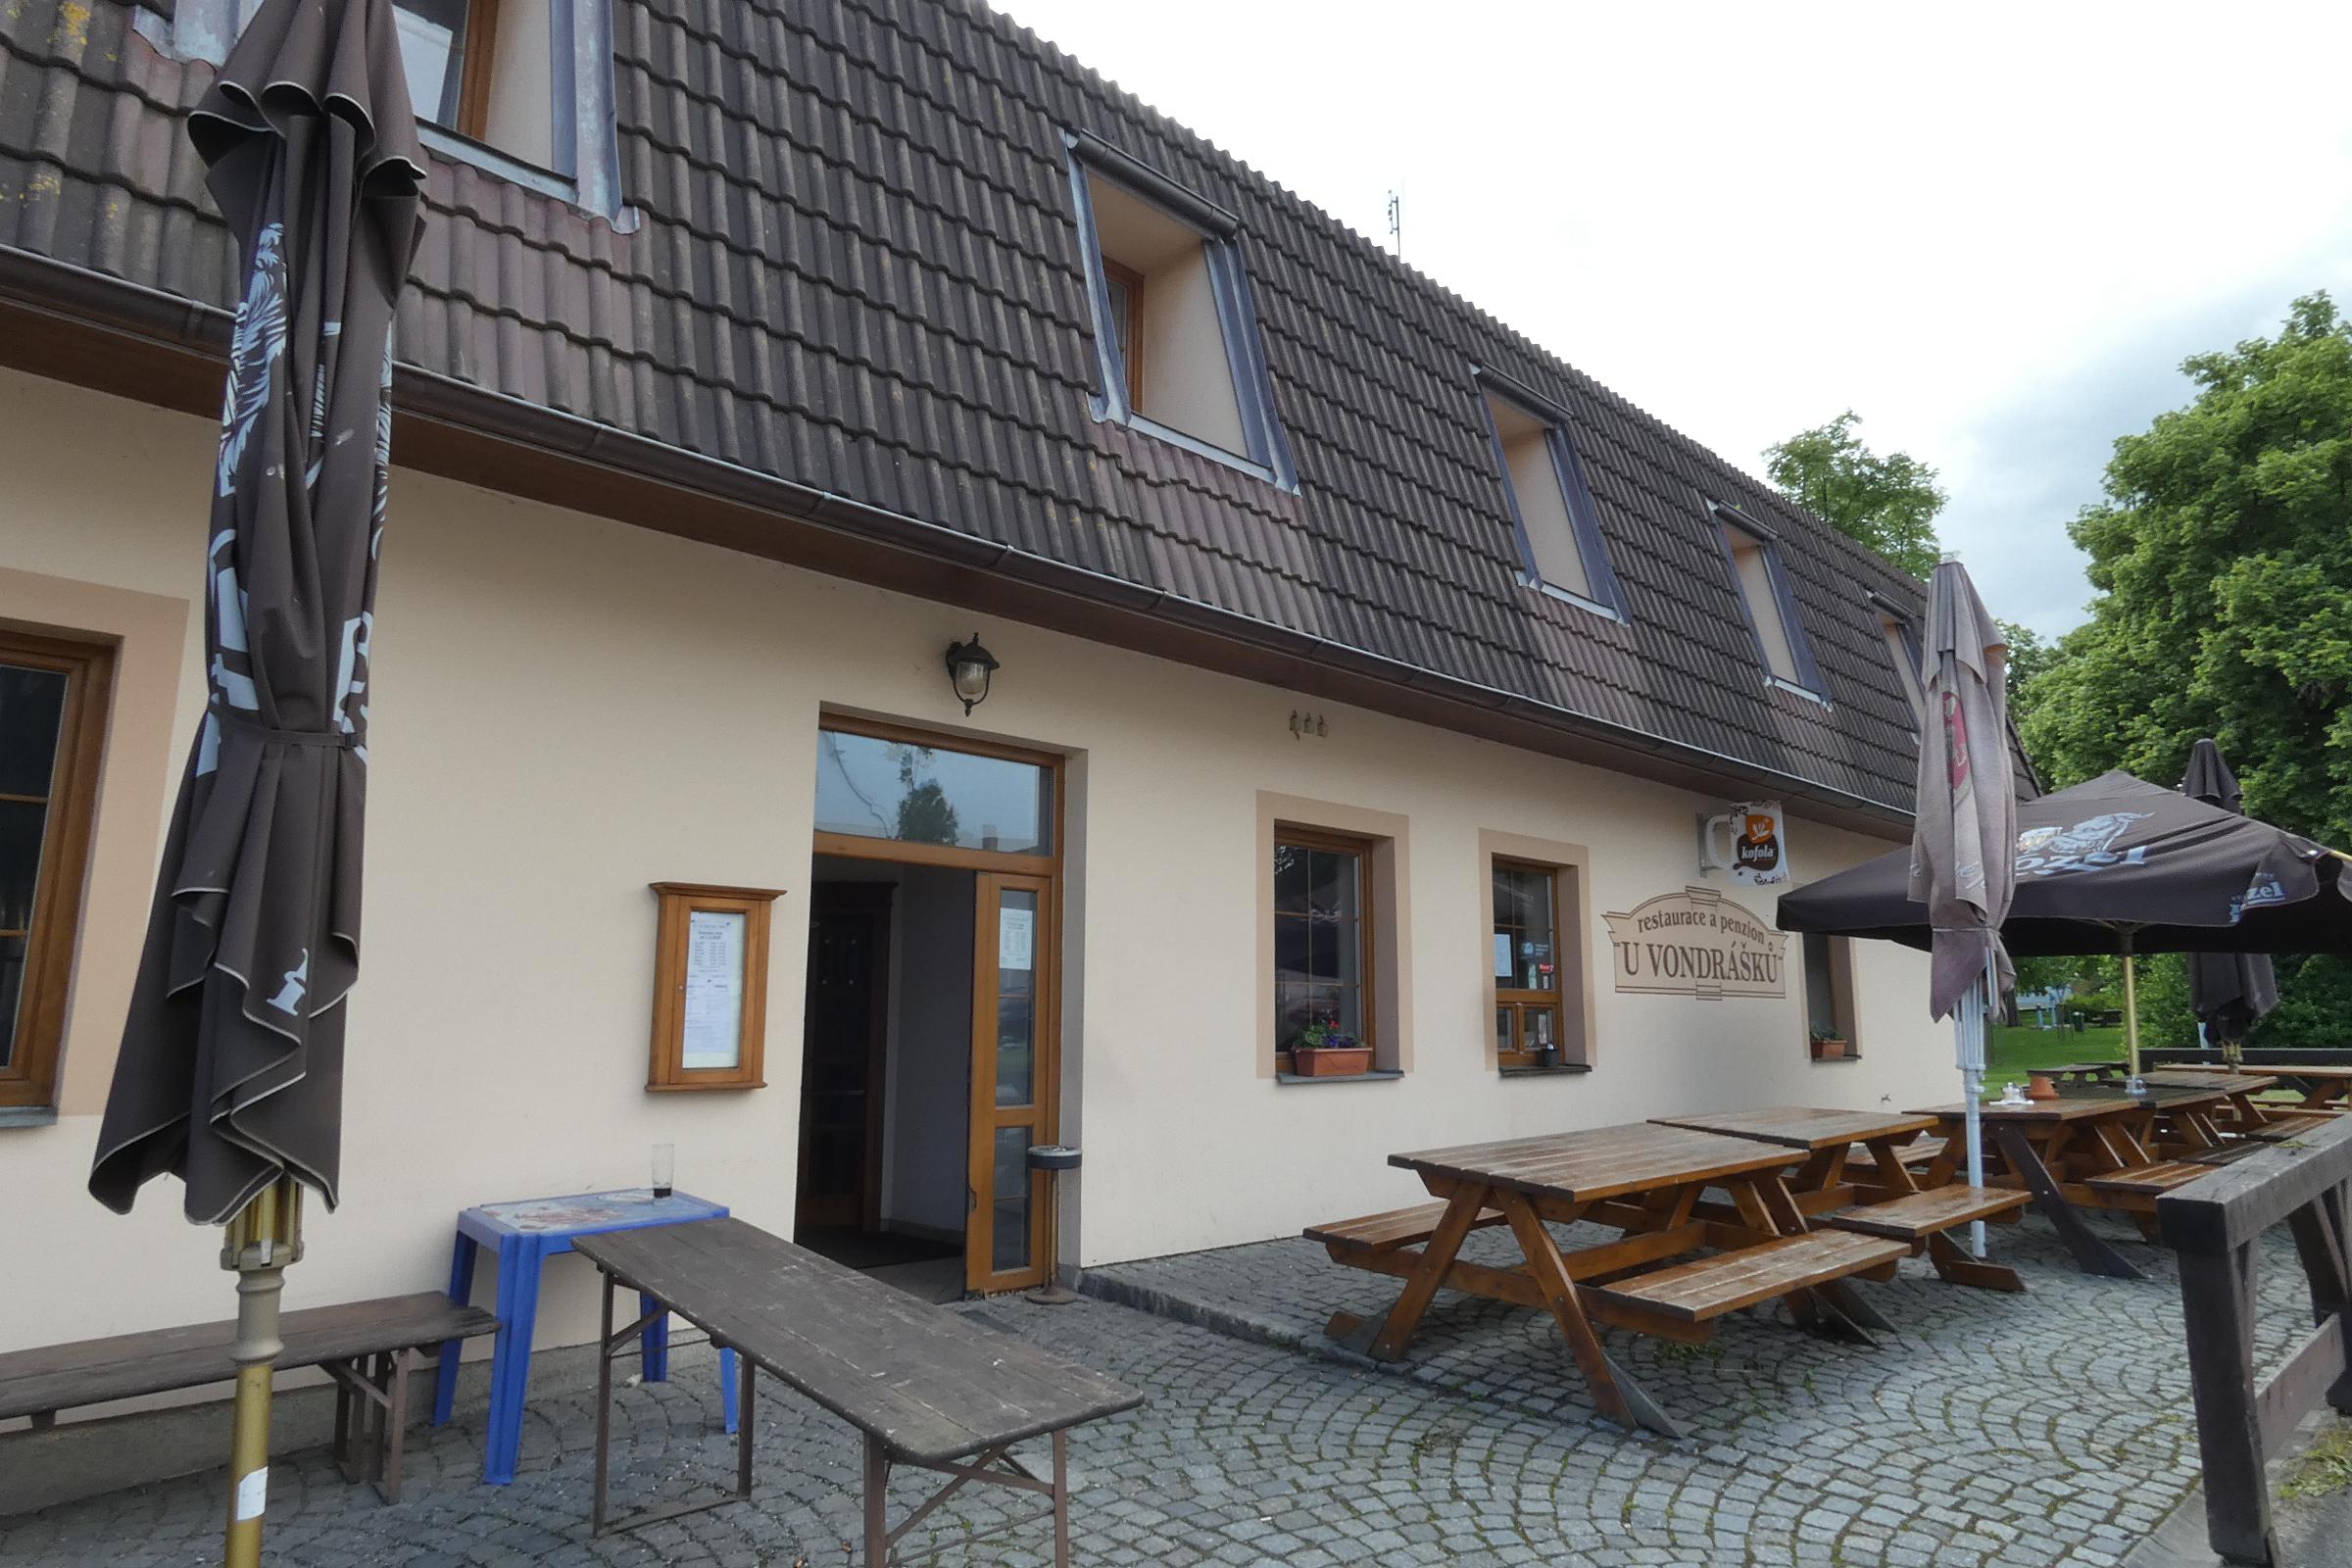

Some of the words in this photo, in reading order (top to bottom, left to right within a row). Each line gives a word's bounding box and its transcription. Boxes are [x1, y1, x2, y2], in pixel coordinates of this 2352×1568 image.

[1741, 845, 1774, 862] kofola
[2016, 846, 2147, 876] ozel
[1638, 909, 1706, 933] restaurace
[1710, 913, 1717, 927] a
[1720, 915, 1765, 944] penzion
[1622, 941, 1640, 976] U
[1646, 940, 1778, 983] VONDRÁŠKŮ
